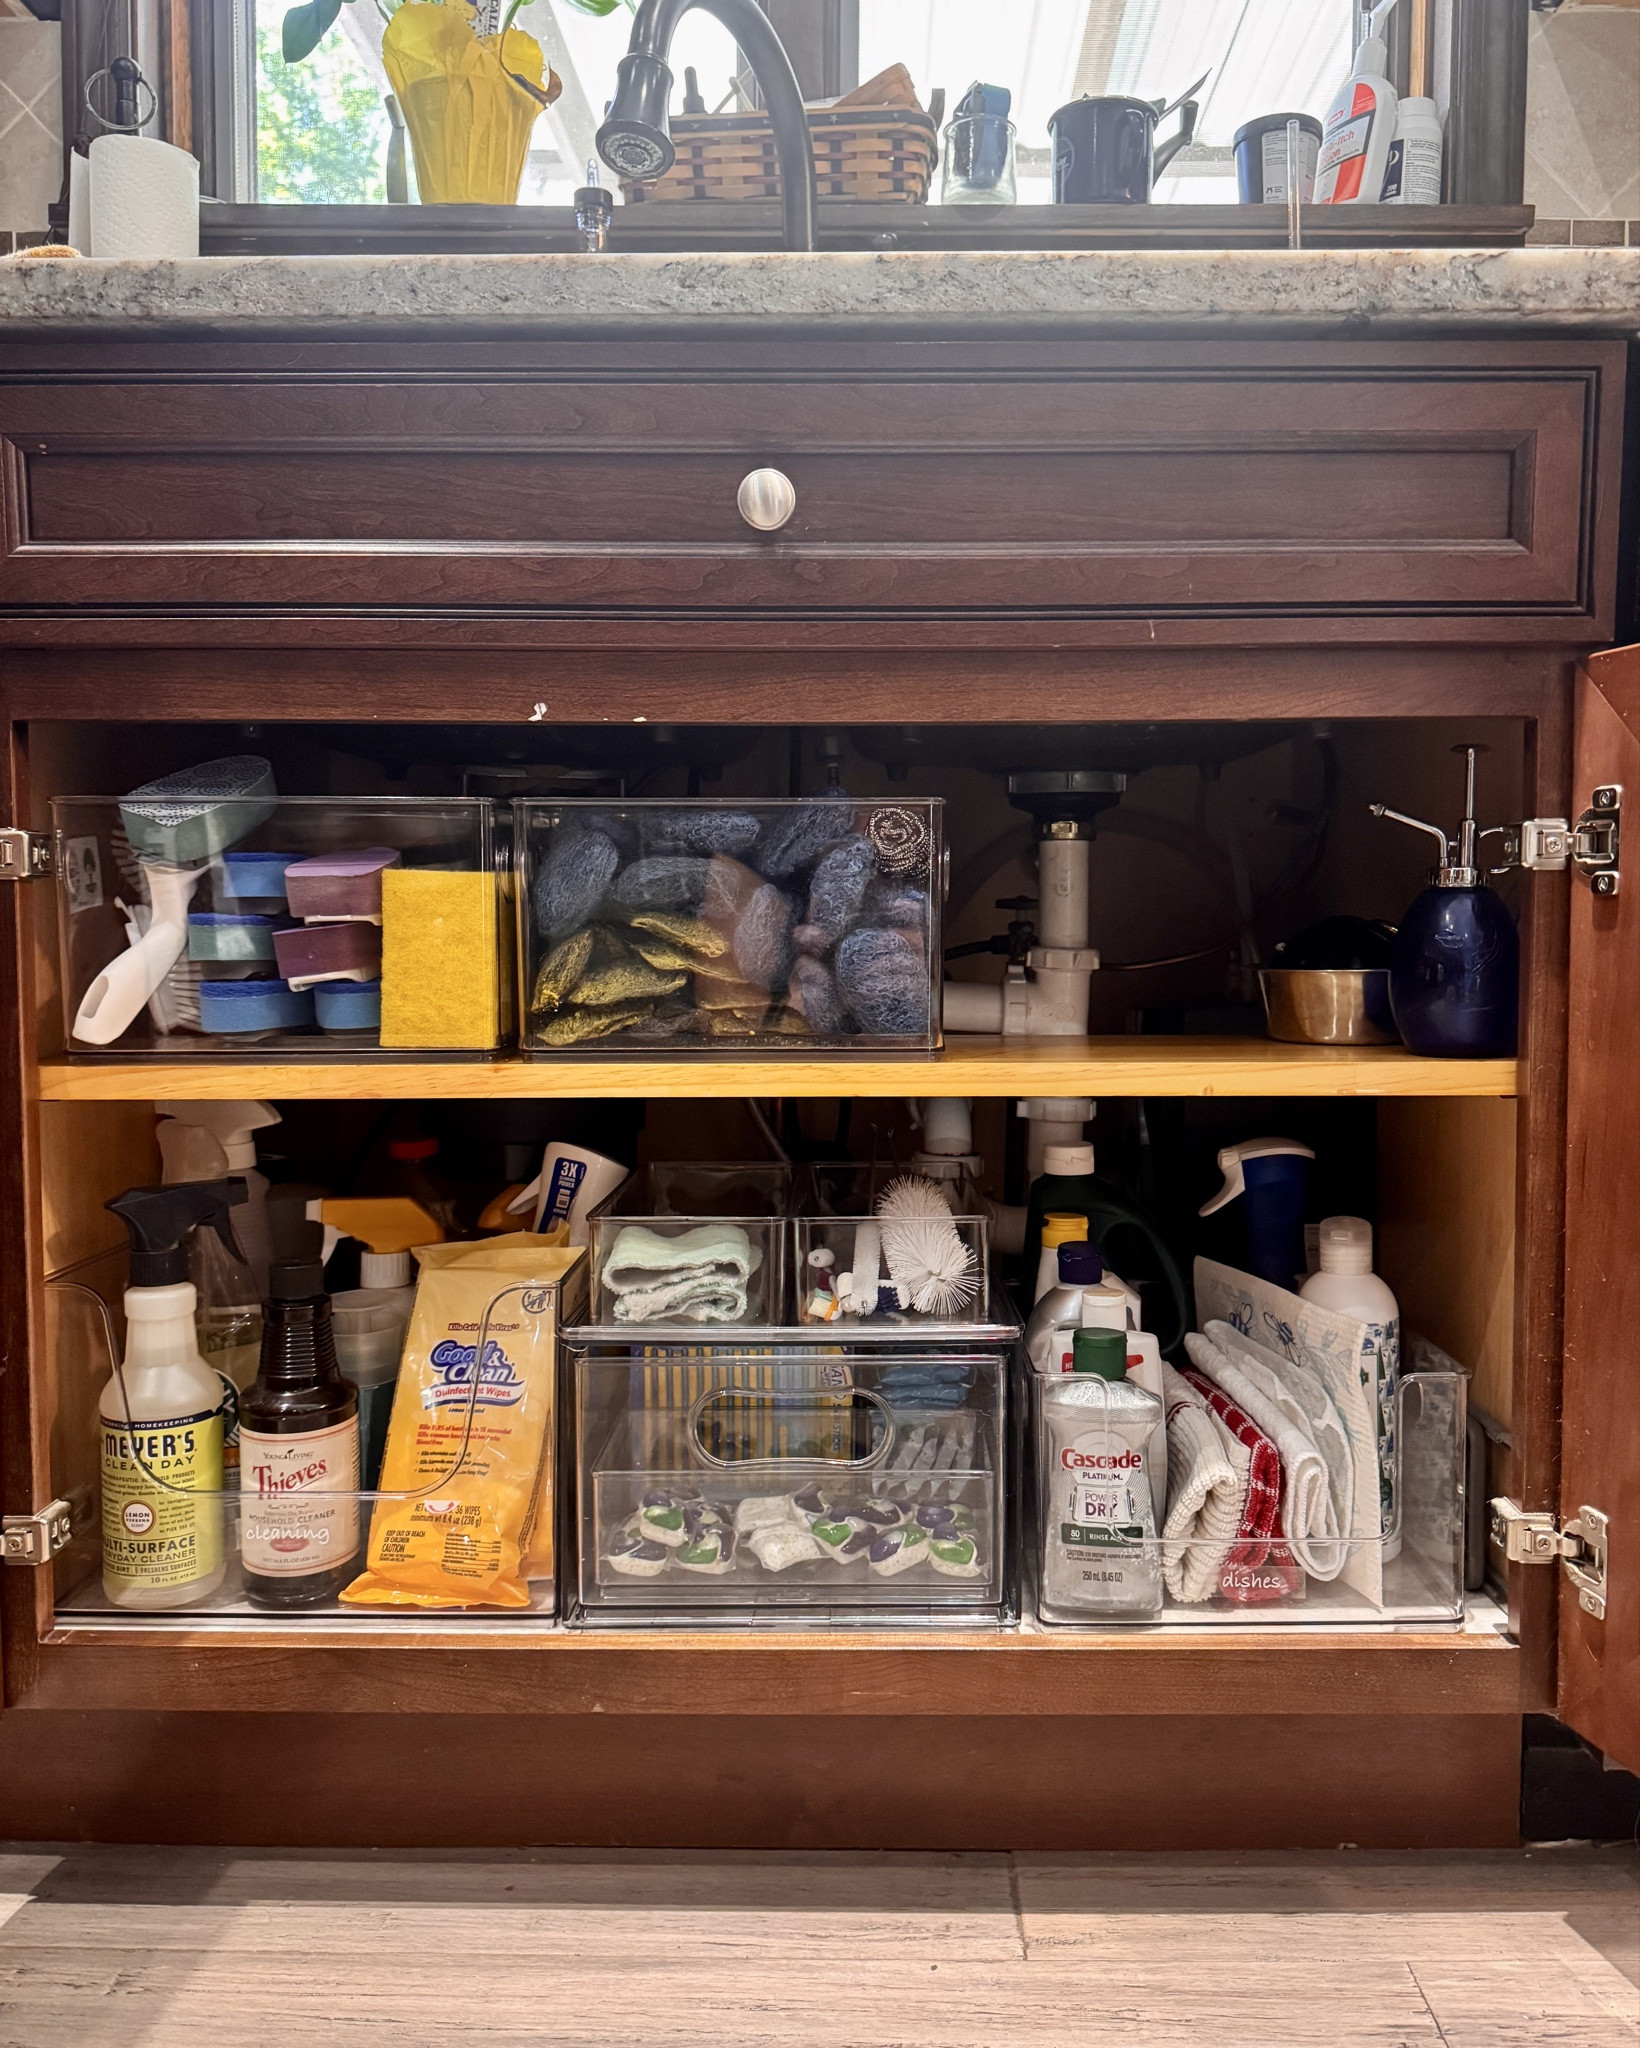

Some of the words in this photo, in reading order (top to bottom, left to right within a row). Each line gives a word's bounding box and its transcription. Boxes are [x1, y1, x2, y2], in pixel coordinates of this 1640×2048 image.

[561, 1161, 578, 1178] 3X
[431, 1340, 497, 1366] Good
[487, 1350, 502, 1366] &
[446, 1362, 511, 1382] Clean
[486, 1387, 511, 1398] Wipes
[134, 1417, 195, 1429] HOMEKEEPING
[105, 1459, 153, 1471] CLEAN
[161, 1455, 195, 1469] DAY
[1061, 1448, 1142, 1469] Cascade
[252, 1459, 327, 1500] Thieves
[297, 1509, 336, 1524] CLEANER
[455, 1505, 463, 1514] 36
[464, 1506, 481, 1516] WIPES
[246, 1524, 330, 1545] cleaning
[1070, 1529, 1081, 1538] 80
[1089, 1533, 1108, 1541] RINSE
[103, 1535, 196, 1554] ULTI-SURFACE
[382, 1543, 405, 1553] CAUTION
[140, 1548, 196, 1563] CLEANER
[1082, 1571, 1092, 1581] 250
[1222, 1571, 1281, 1588] dishes
